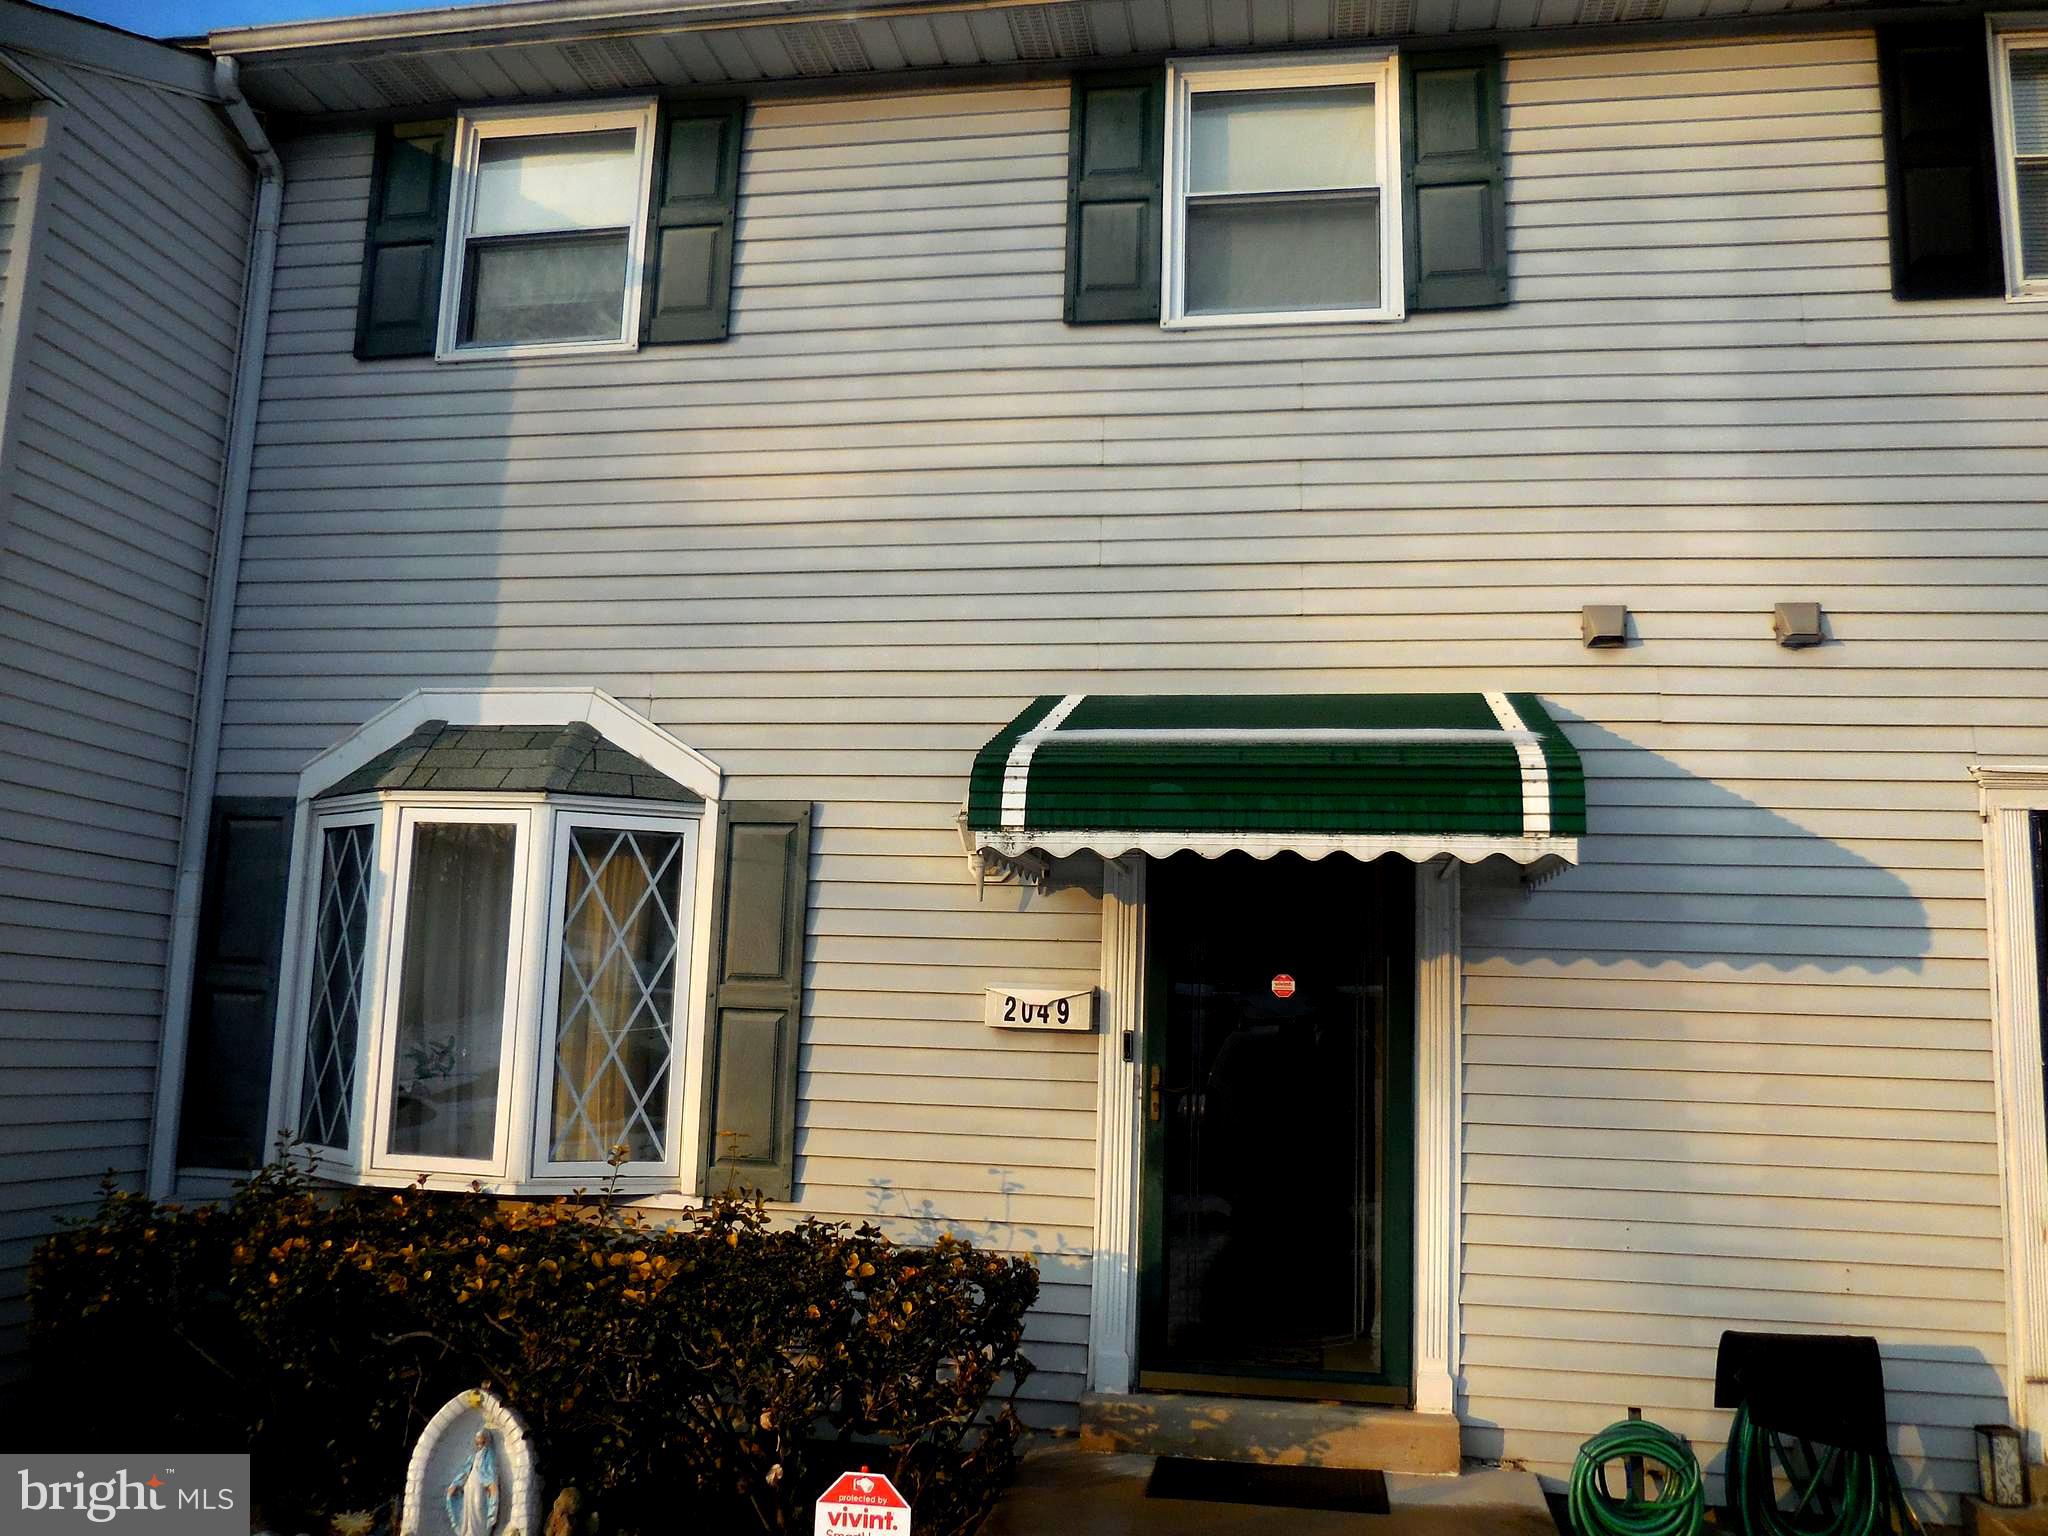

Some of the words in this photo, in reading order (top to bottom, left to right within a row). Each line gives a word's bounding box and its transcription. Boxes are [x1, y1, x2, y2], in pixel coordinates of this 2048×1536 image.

[1003, 996, 1069, 1024] 2049
[838, 1494, 876, 1503] protected
[877, 1497, 888, 1505] by
[827, 1506, 898, 1531] vivint.
